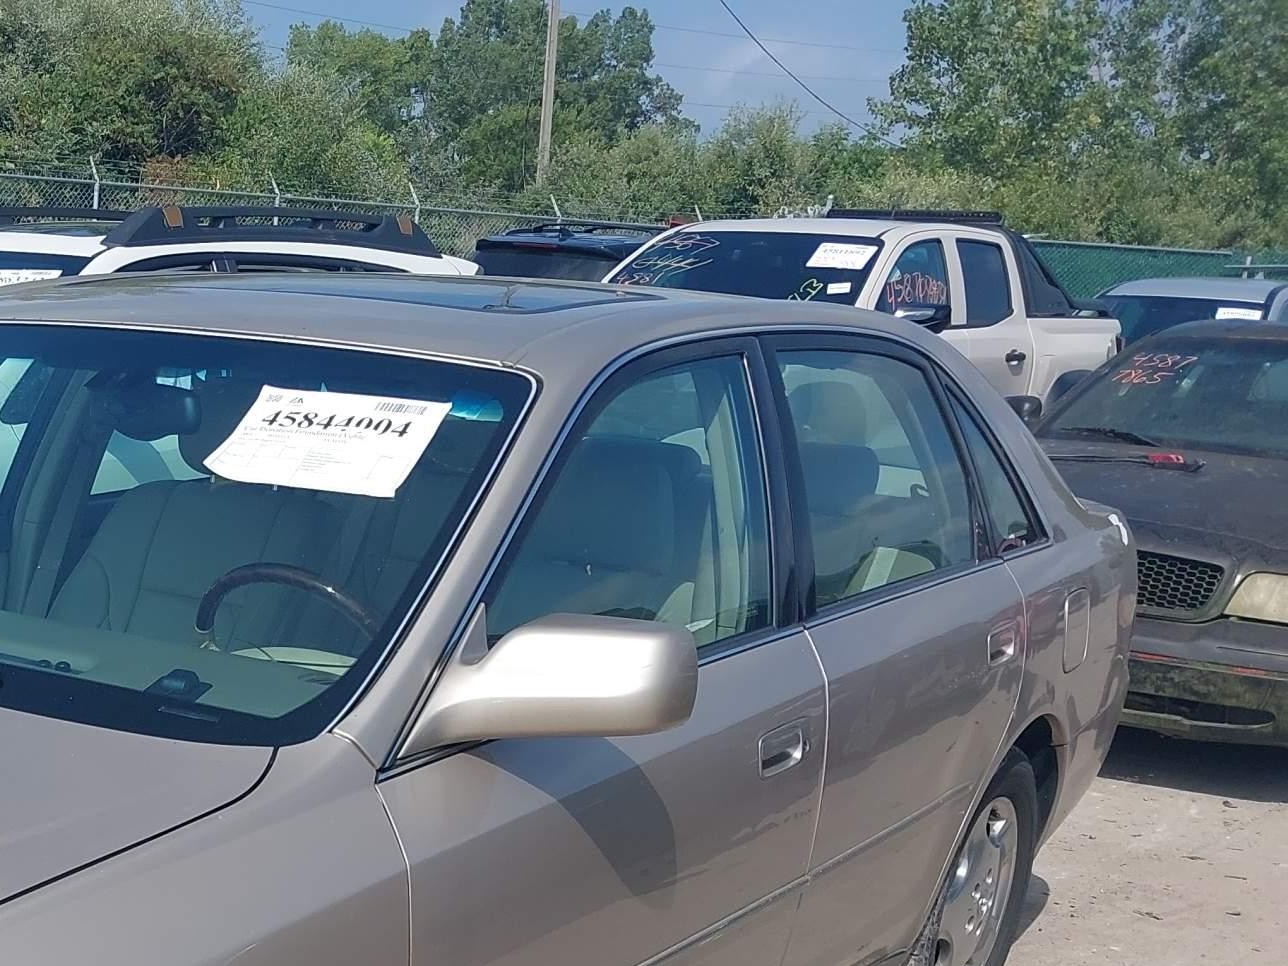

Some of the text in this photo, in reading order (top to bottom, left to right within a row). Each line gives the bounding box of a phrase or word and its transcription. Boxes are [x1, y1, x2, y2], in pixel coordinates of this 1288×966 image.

[1133, 352, 1199, 369] 4587
[1111, 369, 1175, 384] 7865
[261, 409, 412, 438] 45844004
